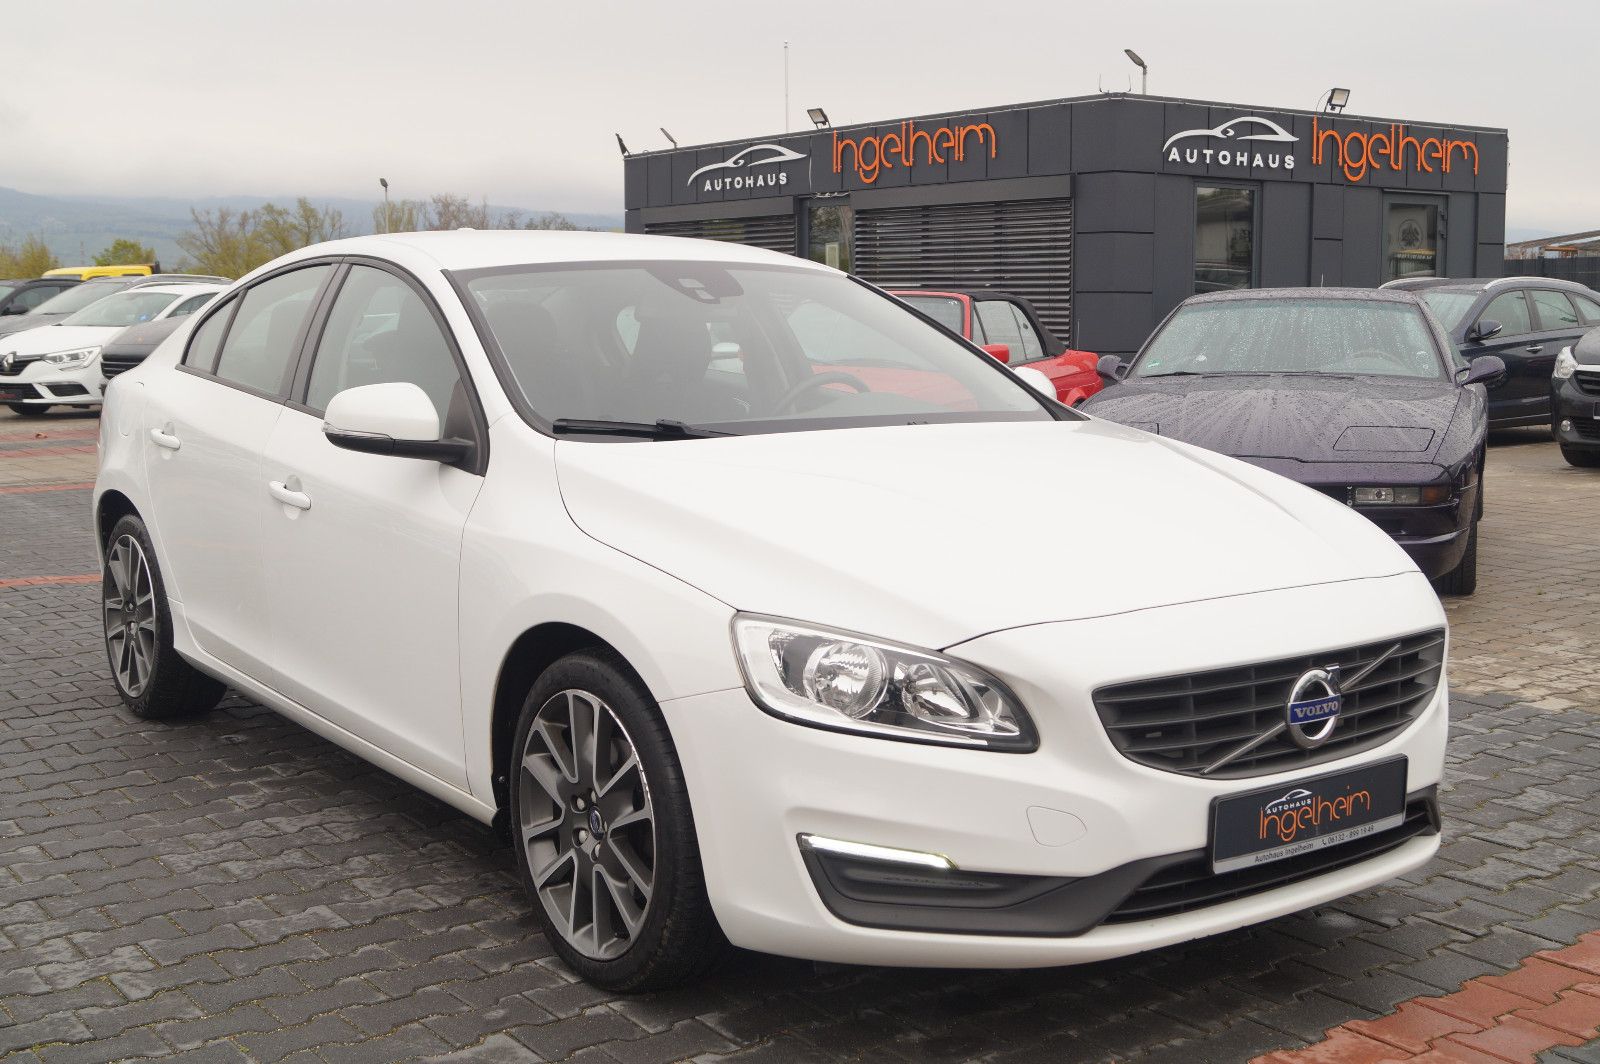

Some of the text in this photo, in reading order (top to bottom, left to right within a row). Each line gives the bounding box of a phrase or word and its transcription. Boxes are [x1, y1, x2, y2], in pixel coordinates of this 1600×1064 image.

[704, 120, 996, 192] AUTOHAUS Ingelheim
[1168, 115, 1479, 182] AUTOHAUS Ingelheim
[1294, 701, 1338, 718] VOLVO
[1259, 785, 1370, 842] Ingelheim
[1266, 799, 1312, 814] AUTOHAUS
[1255, 842, 1314, 863] Autohaus Ingelheim
